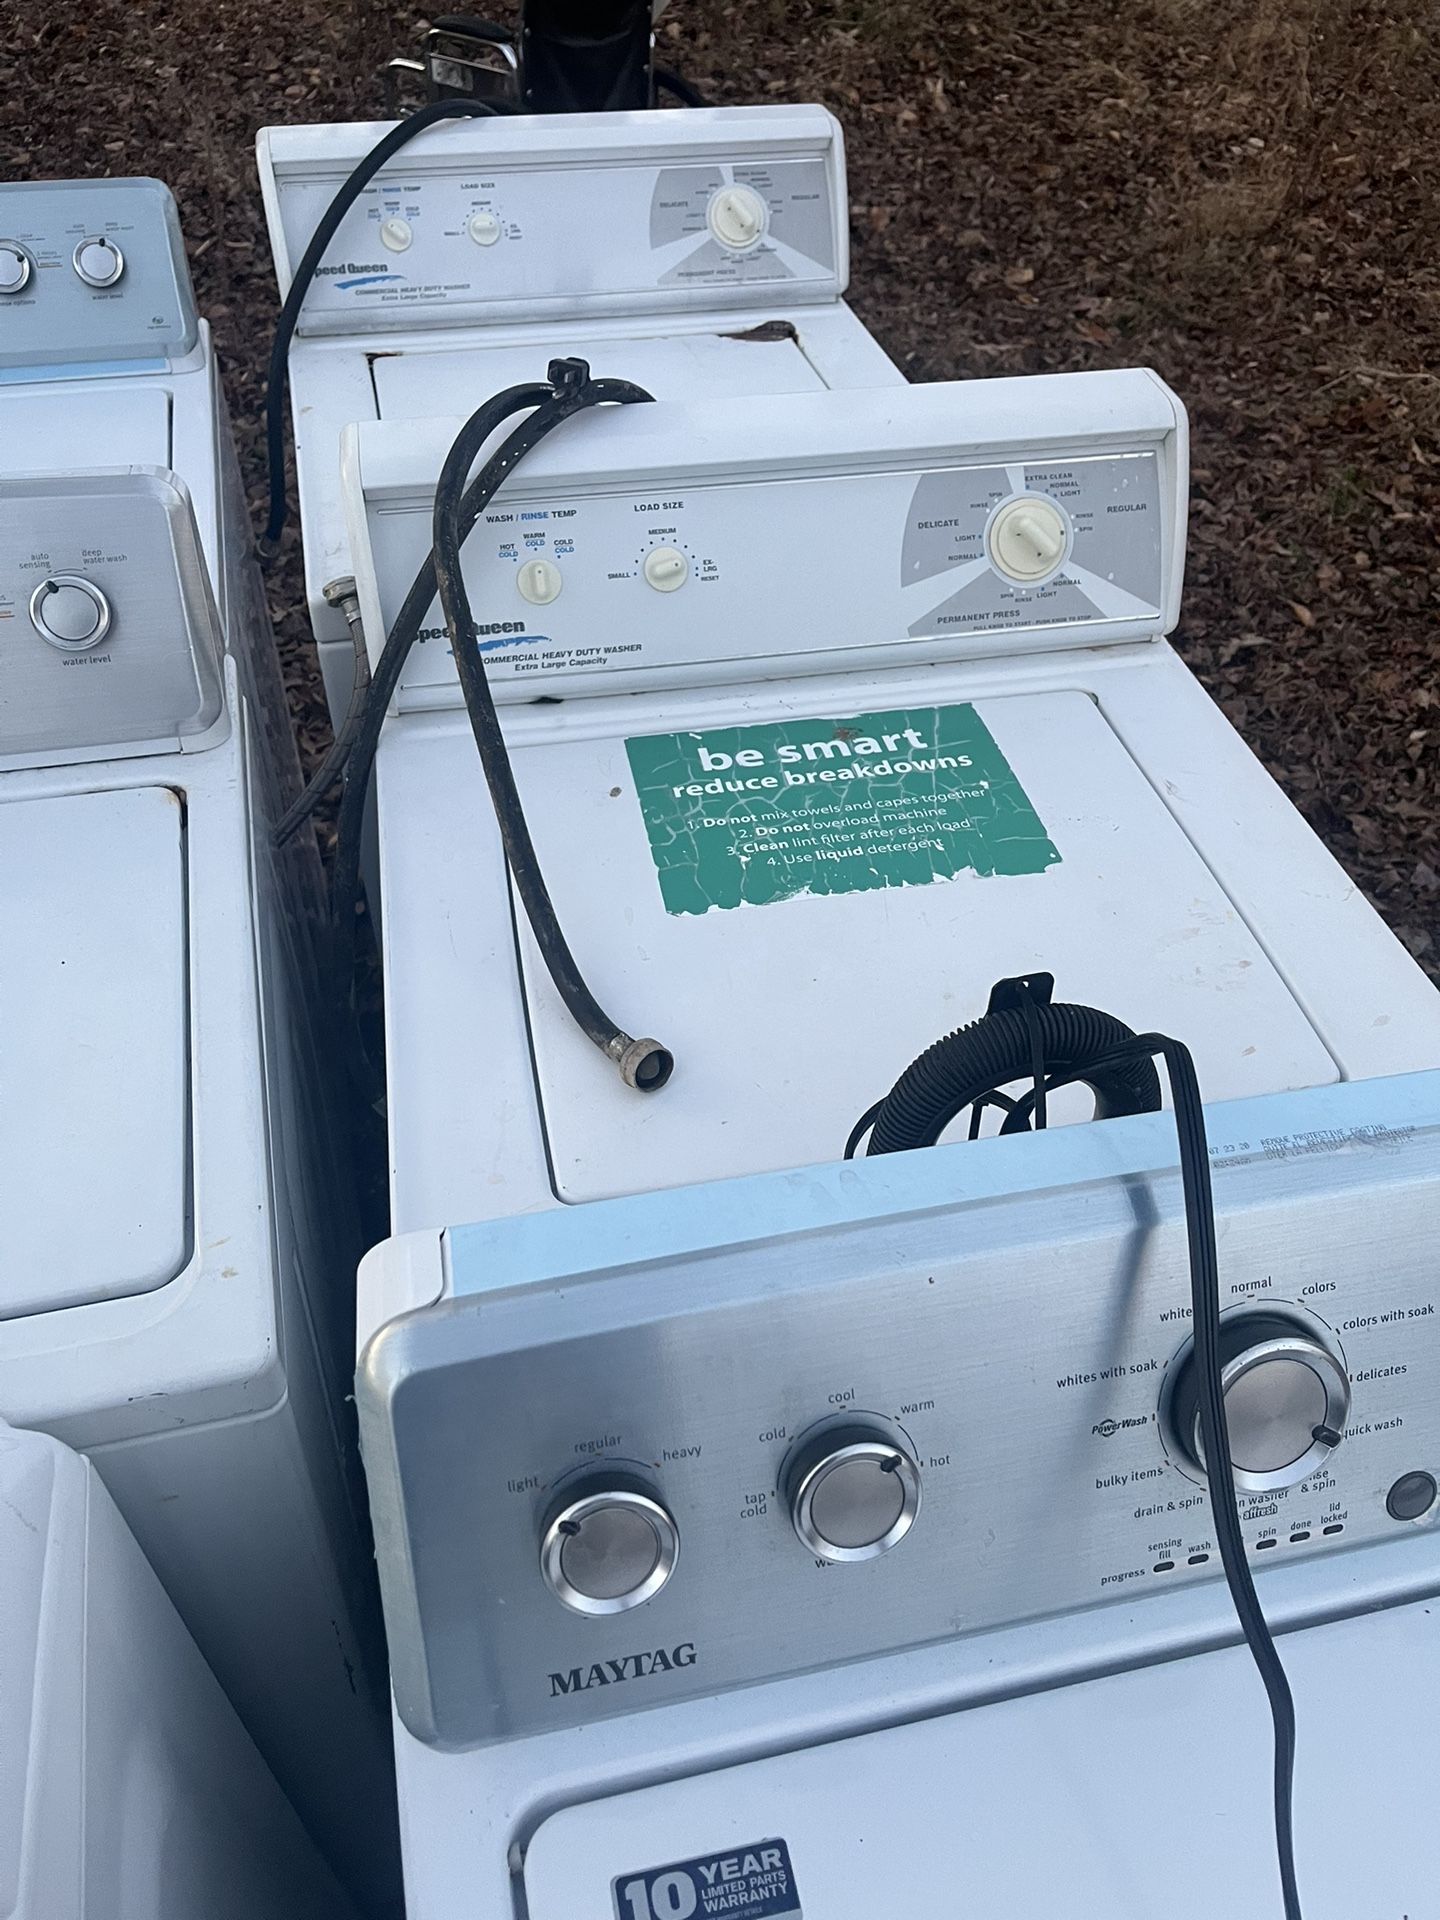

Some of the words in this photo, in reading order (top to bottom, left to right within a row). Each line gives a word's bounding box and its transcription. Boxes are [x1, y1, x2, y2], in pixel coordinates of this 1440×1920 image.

[313, 264, 346, 278] peed
[348, 262, 388, 274] Queen
[1050, 472, 1073, 481] CLEAN
[1050, 480, 1079, 489] NORMAL
[1060, 490, 1081, 498] LIGHT
[634, 504, 660, 512] LOAD
[662, 501, 684, 510] SIZE
[1106, 504, 1147, 514] REGULAR
[486, 514, 514, 524] WASH
[521, 512, 549, 521] RINSE
[552, 510, 577, 519] TEMP
[918, 518, 960, 530] DELICATE
[648, 528, 677, 536] MEDIUM
[954, 534, 976, 542] LIGHT
[554, 538, 574, 546] COLD
[555, 546, 575, 554] COLD
[31, 552, 49, 561] auto
[82, 550, 102, 558] deep
[83, 556, 106, 565] water
[107, 554, 128, 563] wash
[948, 553, 978, 561] NORMAL
[19, 560, 51, 570] sensing
[608, 572, 631, 580] SMALL
[1053, 579, 1082, 587] NORMAL
[1036, 591, 1057, 599] LIGHT
[937, 612, 990, 625] PERMANENT
[992, 610, 1020, 619] PRESS
[62, 658, 87, 666] water
[89, 654, 111, 665] level
[542, 650, 573, 660] HEAVY
[576, 648, 600, 657] DUTY
[604, 644, 642, 654] WASHER
[514, 664, 538, 672] Extra
[542, 660, 567, 670] Large
[569, 656, 608, 668] Capacity
[698, 746, 764, 772] be
[776, 727, 928, 764] smart
[672, 770, 778, 799] reduce
[785, 753, 973, 787] breakdowns
[688, 820, 700, 830] 1.
[704, 818, 727, 828] Do
[731, 814, 758, 825] not
[761, 811, 790, 821] mix
[792, 804, 841, 818] towels
[844, 800, 873, 812] and
[876, 797, 919, 809] capes
[921, 788, 986, 803] together
[739, 830, 753, 839] 2.
[756, 827, 779, 837] Do
[782, 823, 811, 833] not
[813, 814, 880, 830] overload
[883, 808, 947, 822] machine
[743, 840, 789, 854] Clean
[792, 836, 819, 847] lint
[820, 832, 856, 845] filter
[860, 828, 898, 840] after
[898, 822, 935, 836] each
[938, 818, 971, 831] load
[767, 856, 781, 866] 4.
[784, 854, 813, 865] Use
[815, 846, 864, 862] liquid
[868, 838, 944, 855] detergent
[1223, 1144, 1236, 1153] 23
[1230, 1276, 1273, 1295] normal
[1302, 1280, 1337, 1297] colors
[1160, 1307, 1193, 1322] white
[1343, 1313, 1378, 1331] colors
[1380, 1308, 1406, 1324] with
[1408, 1304, 1435, 1320] soak
[1056, 1372, 1098, 1389] whites
[1100, 1365, 1126, 1381] with
[1130, 1359, 1158, 1376] soak
[1356, 1363, 1408, 1383] delicates
[828, 1388, 856, 1404] cool
[900, 1399, 936, 1417] warm
[1091, 1416, 1148, 1438] PowerWash
[1374, 1416, 1403, 1433] wash
[574, 1432, 622, 1454] regular
[758, 1427, 787, 1444] cold
[662, 1444, 702, 1464] heavy
[929, 1454, 951, 1469] hot
[507, 1475, 539, 1494] light
[1095, 1472, 1129, 1491] bulky
[1130, 1466, 1164, 1482] items
[1300, 1483, 1309, 1493] &
[1312, 1478, 1336, 1492] spin
[744, 1491, 767, 1508] tap
[1134, 1502, 1165, 1519] drain
[1166, 1500, 1176, 1512] &
[1178, 1494, 1204, 1513] spin
[1329, 1502, 1341, 1512] lid
[740, 1504, 768, 1520] cold
[1242, 1502, 1279, 1521] affresh
[1320, 1510, 1348, 1525] locked
[1258, 1527, 1278, 1539] spin
[1290, 1520, 1312, 1532] done
[1148, 1536, 1183, 1553] sensing
[1188, 1540, 1212, 1555] wash
[1158, 1548, 1172, 1561] fill
[1100, 1568, 1146, 1587] progress
[548, 1642, 698, 1698] MAYTAG
[624, 1871, 698, 1920] 10
[698, 1848, 784, 1885] YEAR
[702, 1880, 747, 1900] LIMITED
[750, 1870, 787, 1889] PARTS
[703, 1882, 789, 1914] WARRANTY
